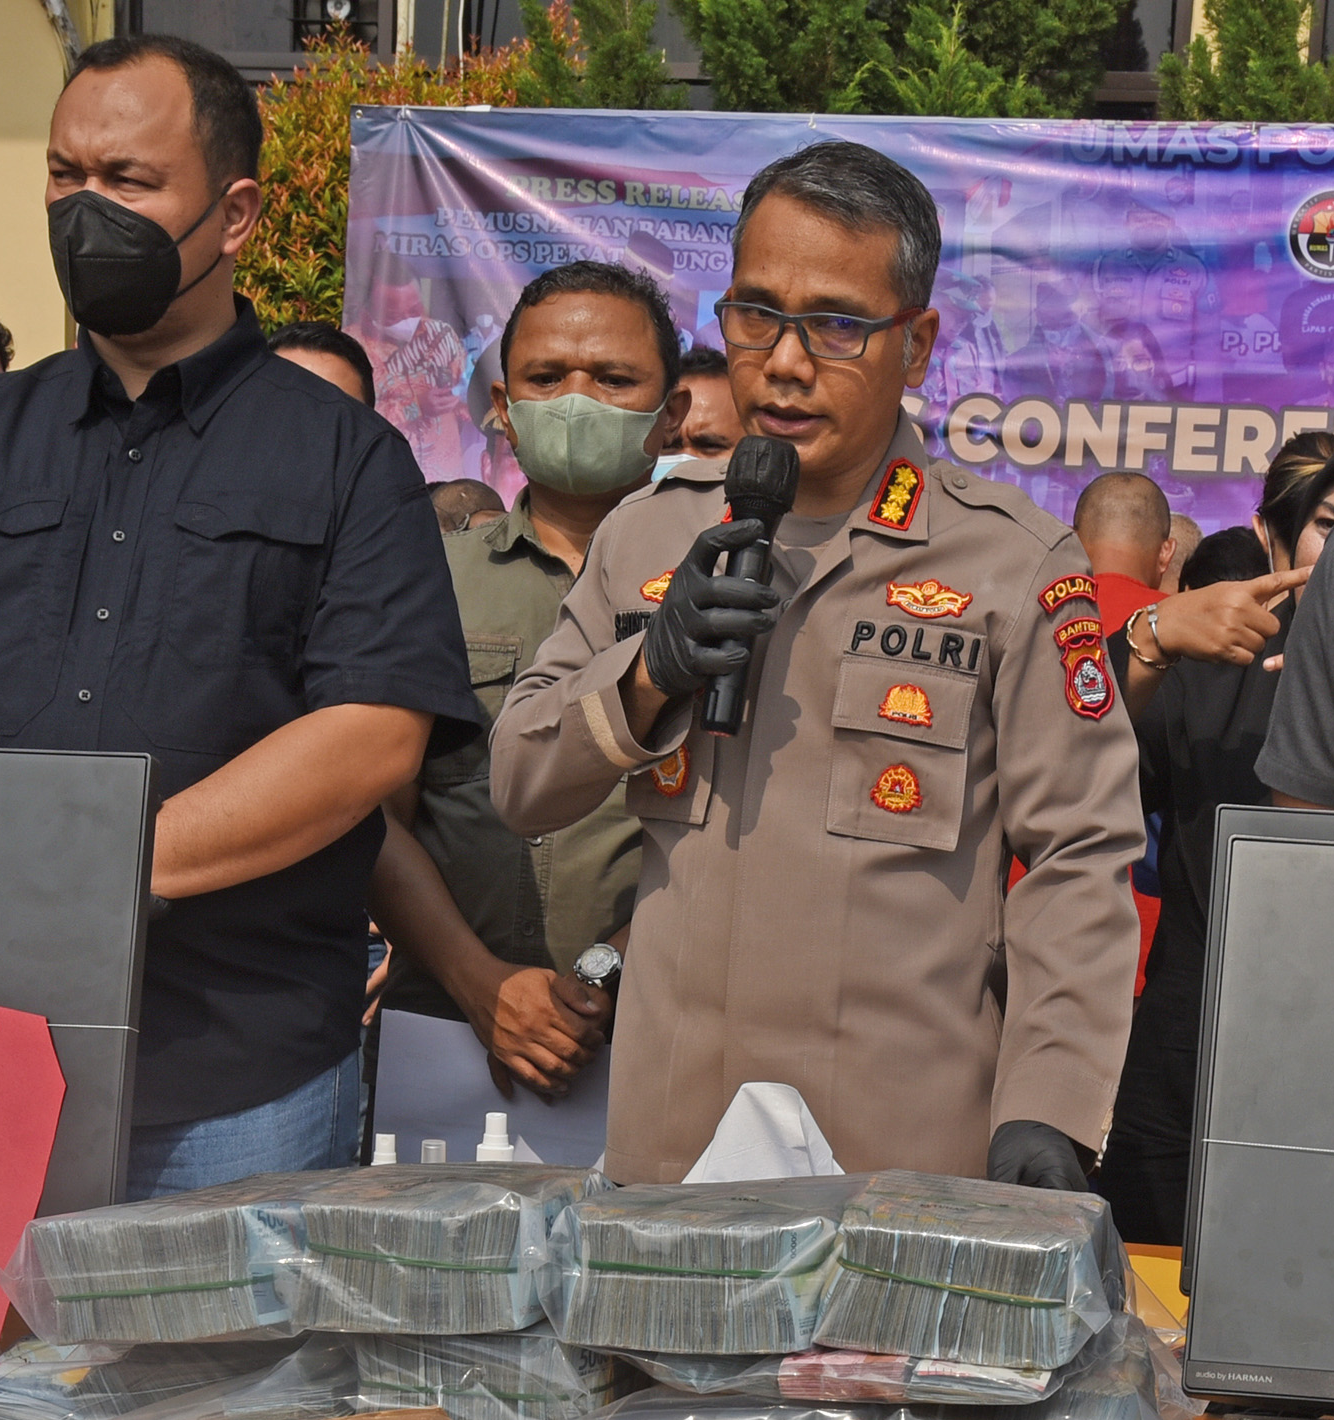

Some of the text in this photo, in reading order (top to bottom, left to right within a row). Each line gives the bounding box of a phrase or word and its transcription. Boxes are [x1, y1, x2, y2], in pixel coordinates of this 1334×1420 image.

[507, 175, 617, 205] PRESS
[435, 208, 635, 239] PEMUSNAHAN
[373, 231, 469, 258] MIRAS
[472, 240, 530, 263] OPS
[534, 241, 625, 265] PEKAT
[1044, 576, 1093, 607] POLDA
[851, 620, 981, 671] POLRI
[1195, 1371, 1273, 1383] audio by HARMAN
